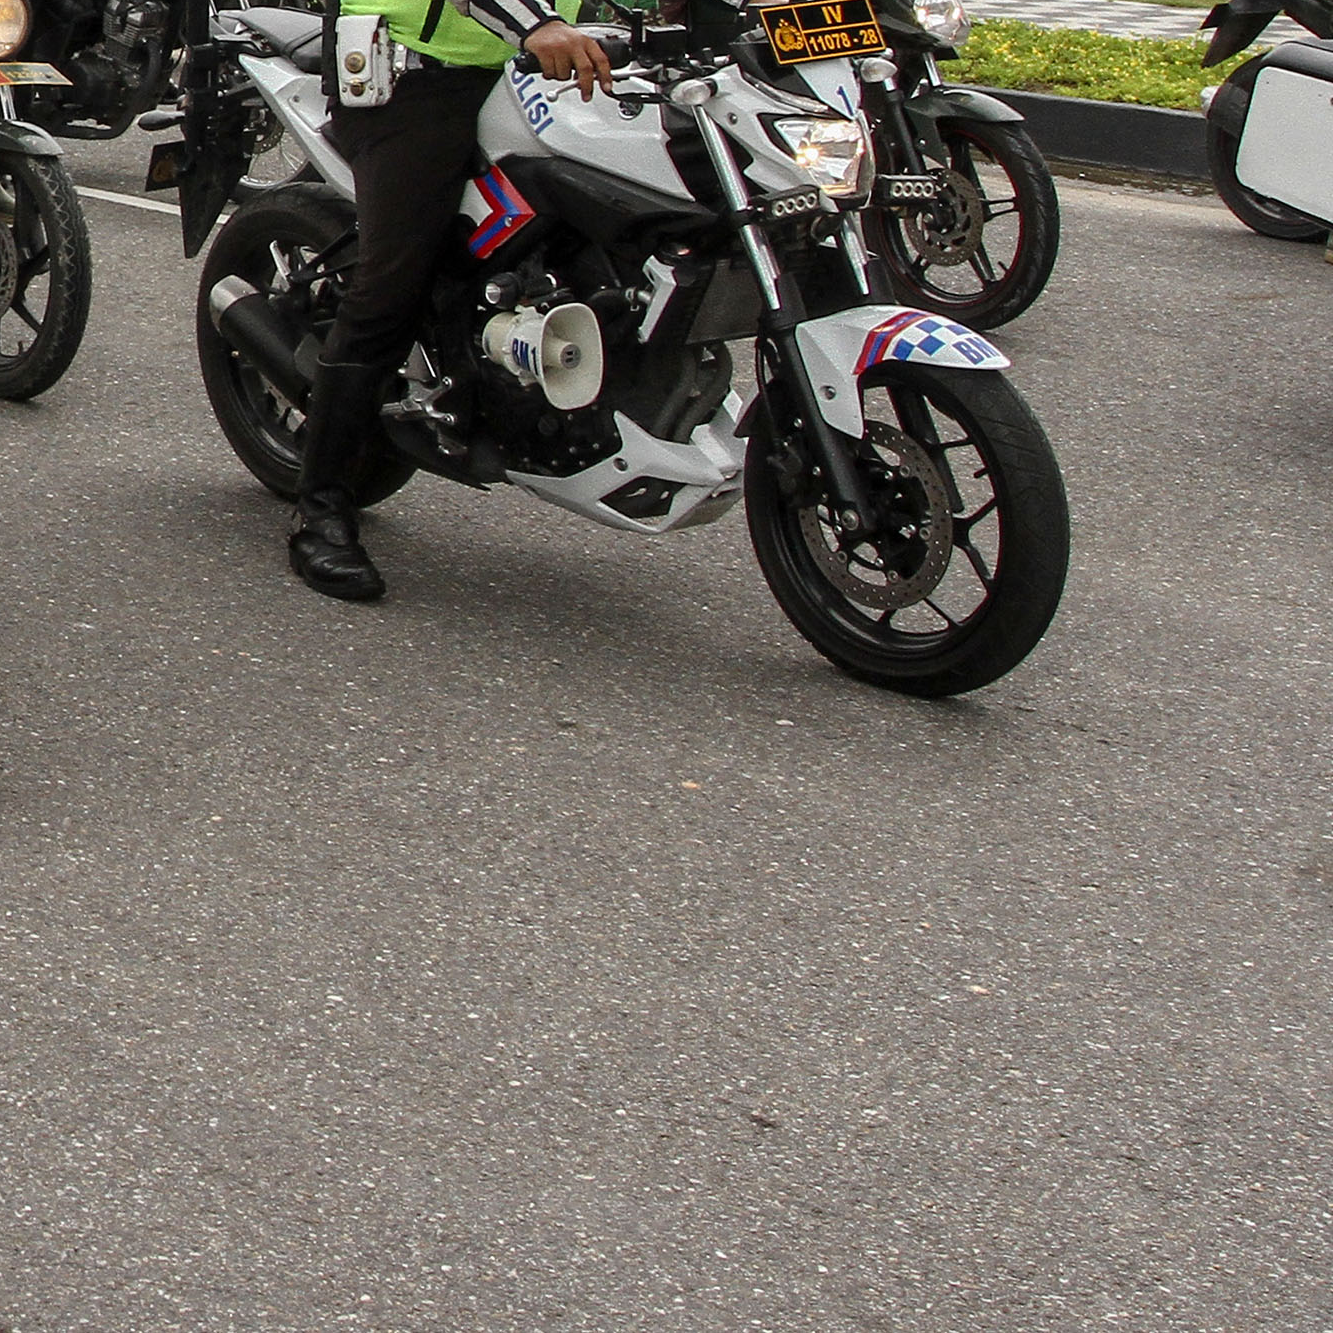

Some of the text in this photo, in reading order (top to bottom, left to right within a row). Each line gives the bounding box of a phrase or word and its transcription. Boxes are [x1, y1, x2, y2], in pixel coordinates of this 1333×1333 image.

[821, 5, 843, 24] IV
[809, 32, 851, 52] 11078
[859, 28, 879, 45] 28
[507, 58, 554, 135] OLISI
[952, 336, 1001, 366] BM
